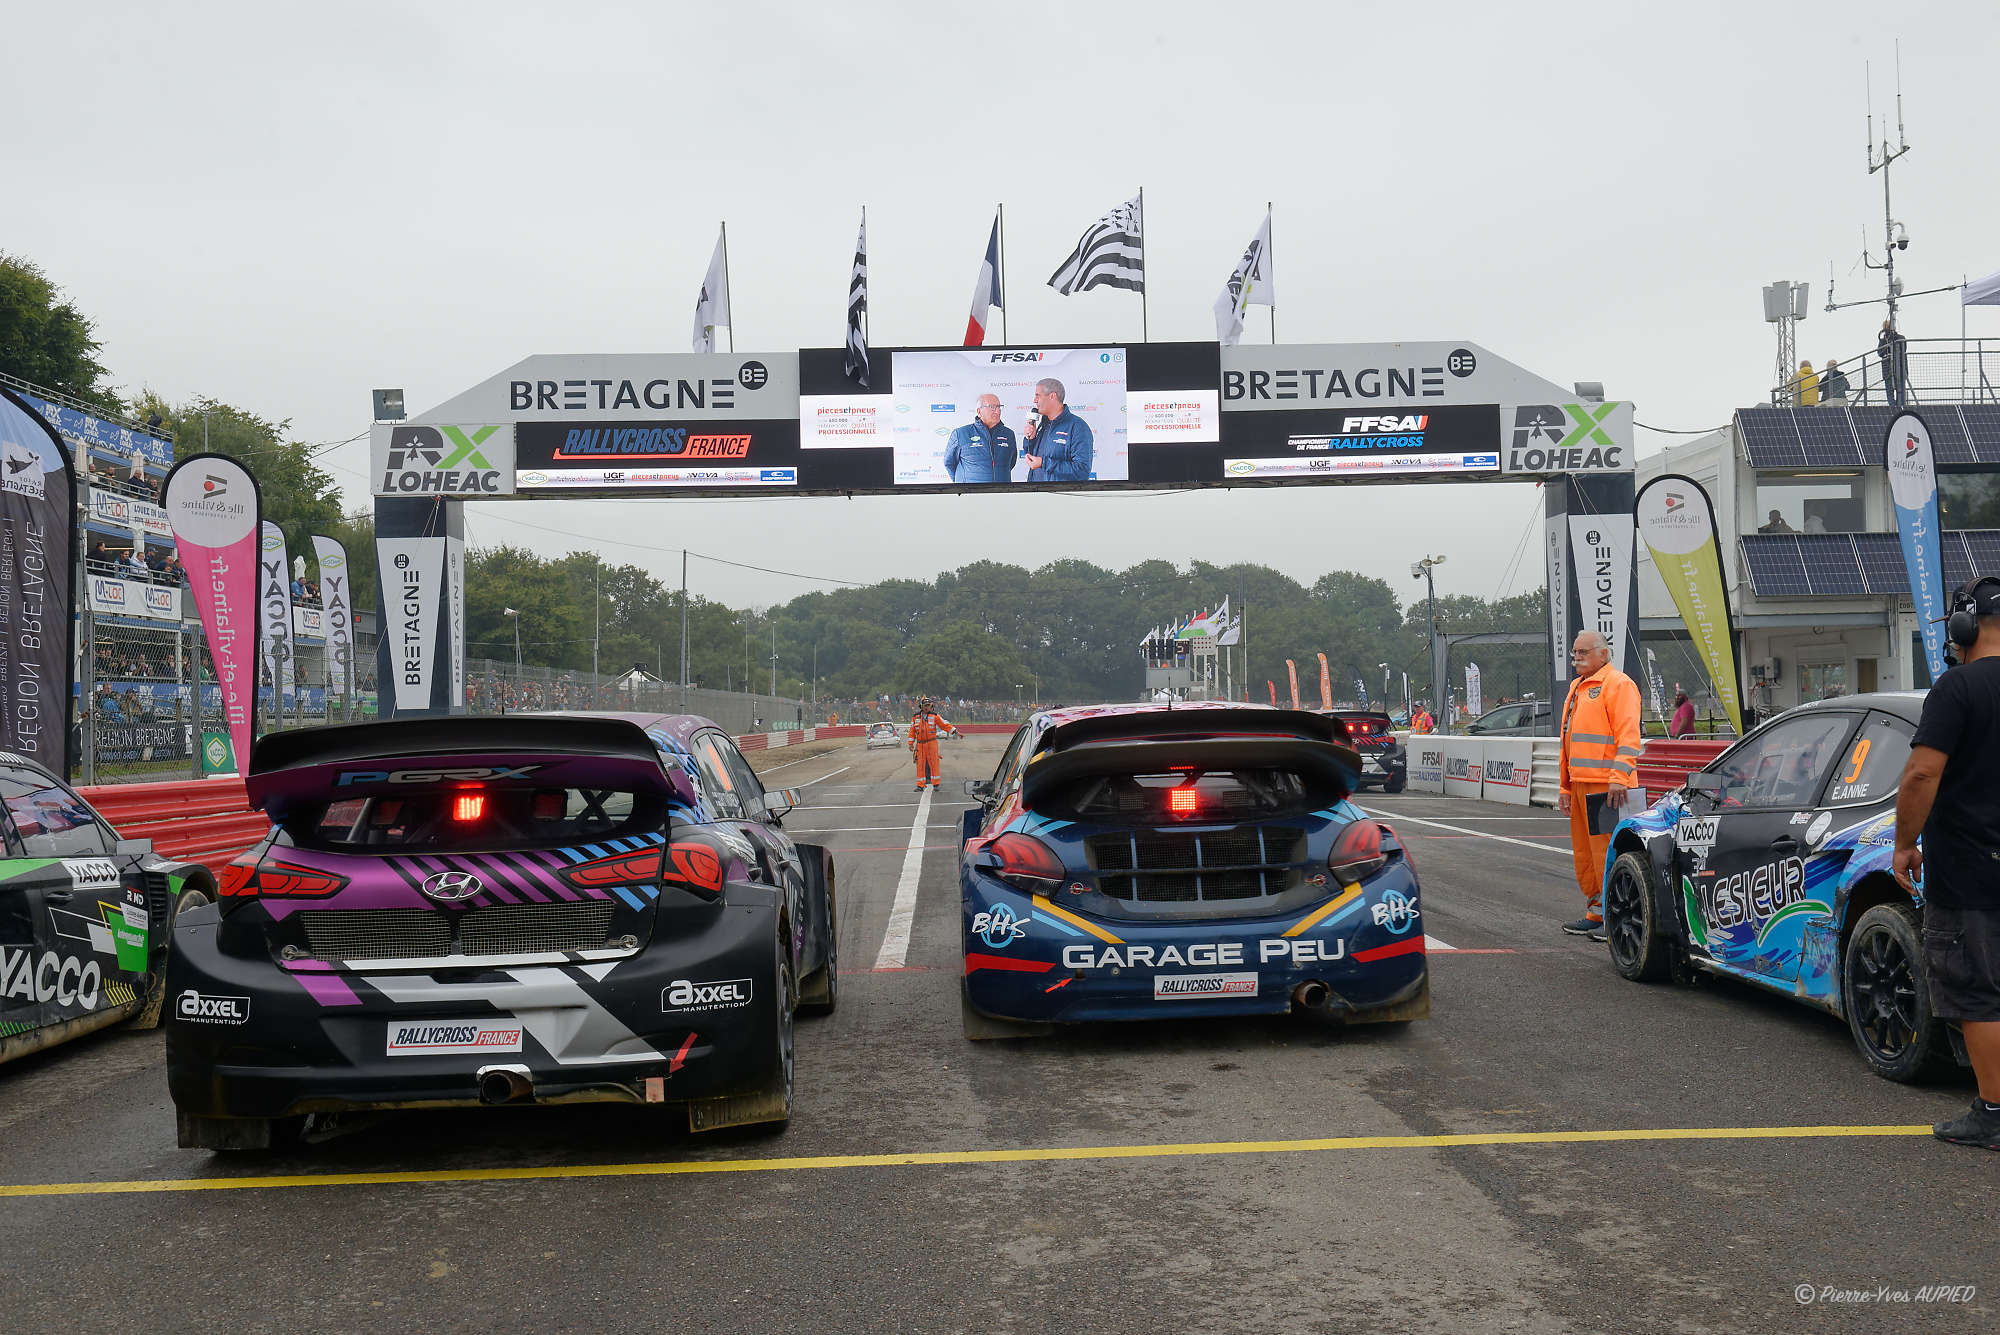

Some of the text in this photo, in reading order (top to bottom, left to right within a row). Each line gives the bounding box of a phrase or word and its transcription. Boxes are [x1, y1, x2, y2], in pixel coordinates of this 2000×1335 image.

[990, 352, 1038, 363] FFSA
[510, 379, 735, 410] BRETAGNE
[1223, 367, 1445, 401] BRETAGNE
[1342, 416, 1419, 432] FFSA
[1512, 403, 1619, 449] RX
[386, 425, 500, 470] RX
[563, 428, 748, 456] RALLYCROSS FRANCE
[1328, 437, 1424, 450] RALLYCROSS
[1509, 447, 1622, 471] LOHEAC
[382, 471, 500, 493] LOHEAC
[603, 472, 624, 480] UGF
[403, 570, 421, 685] BRETAGNE
[1843, 739, 1872, 783] 9
[1831, 783, 1870, 801] E.ANNE
[1682, 823, 1715, 841] YACCO
[69, 863, 118, 884] YACCO
[1700, 856, 1806, 930] LESIEUR
[1062, 938, 1345, 969] GARAGE PEU
[0, 948, 101, 1010] YACCO
[1160, 977, 1256, 995] RALLYCROSS FRANCE
[683, 1001, 746, 1013] MANUTENTION
[190, 1017, 242, 1026] MANUTENTION
[395, 1027, 518, 1046] RALLYCROSS FRANCE
